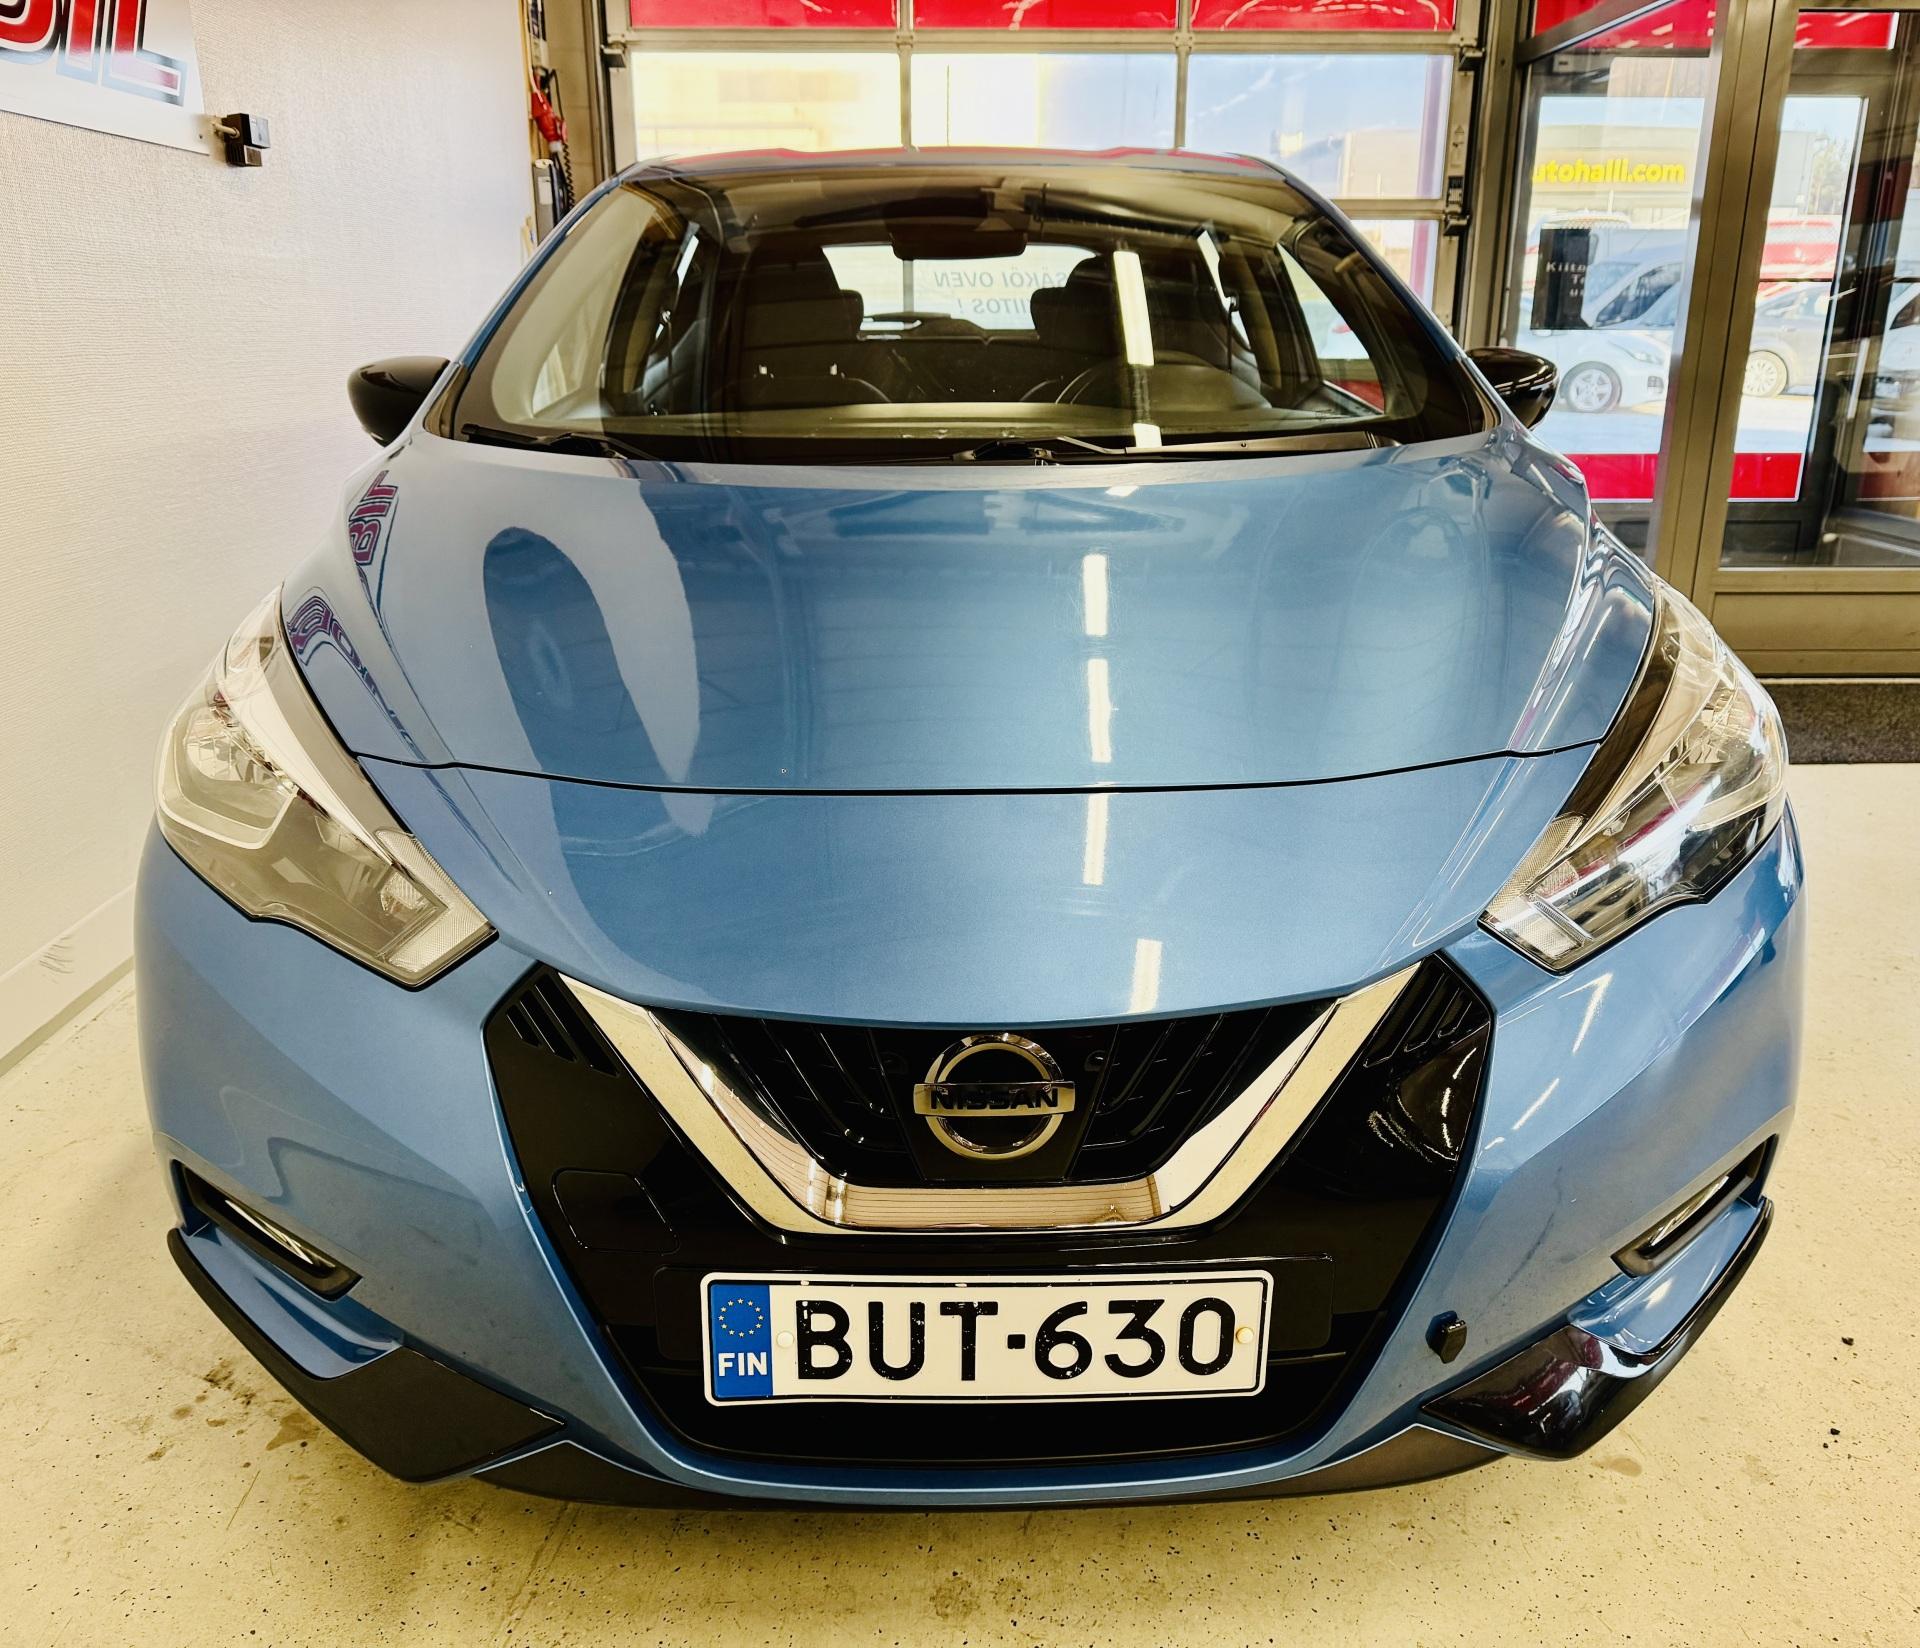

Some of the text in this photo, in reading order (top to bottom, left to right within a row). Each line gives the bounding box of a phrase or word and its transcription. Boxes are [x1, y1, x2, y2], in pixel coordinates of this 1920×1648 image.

[1532, 158, 1685, 184] utohalli.com
[930, 1087, 1059, 1110] NISSAN
[718, 1351, 768, 1377] FIN
